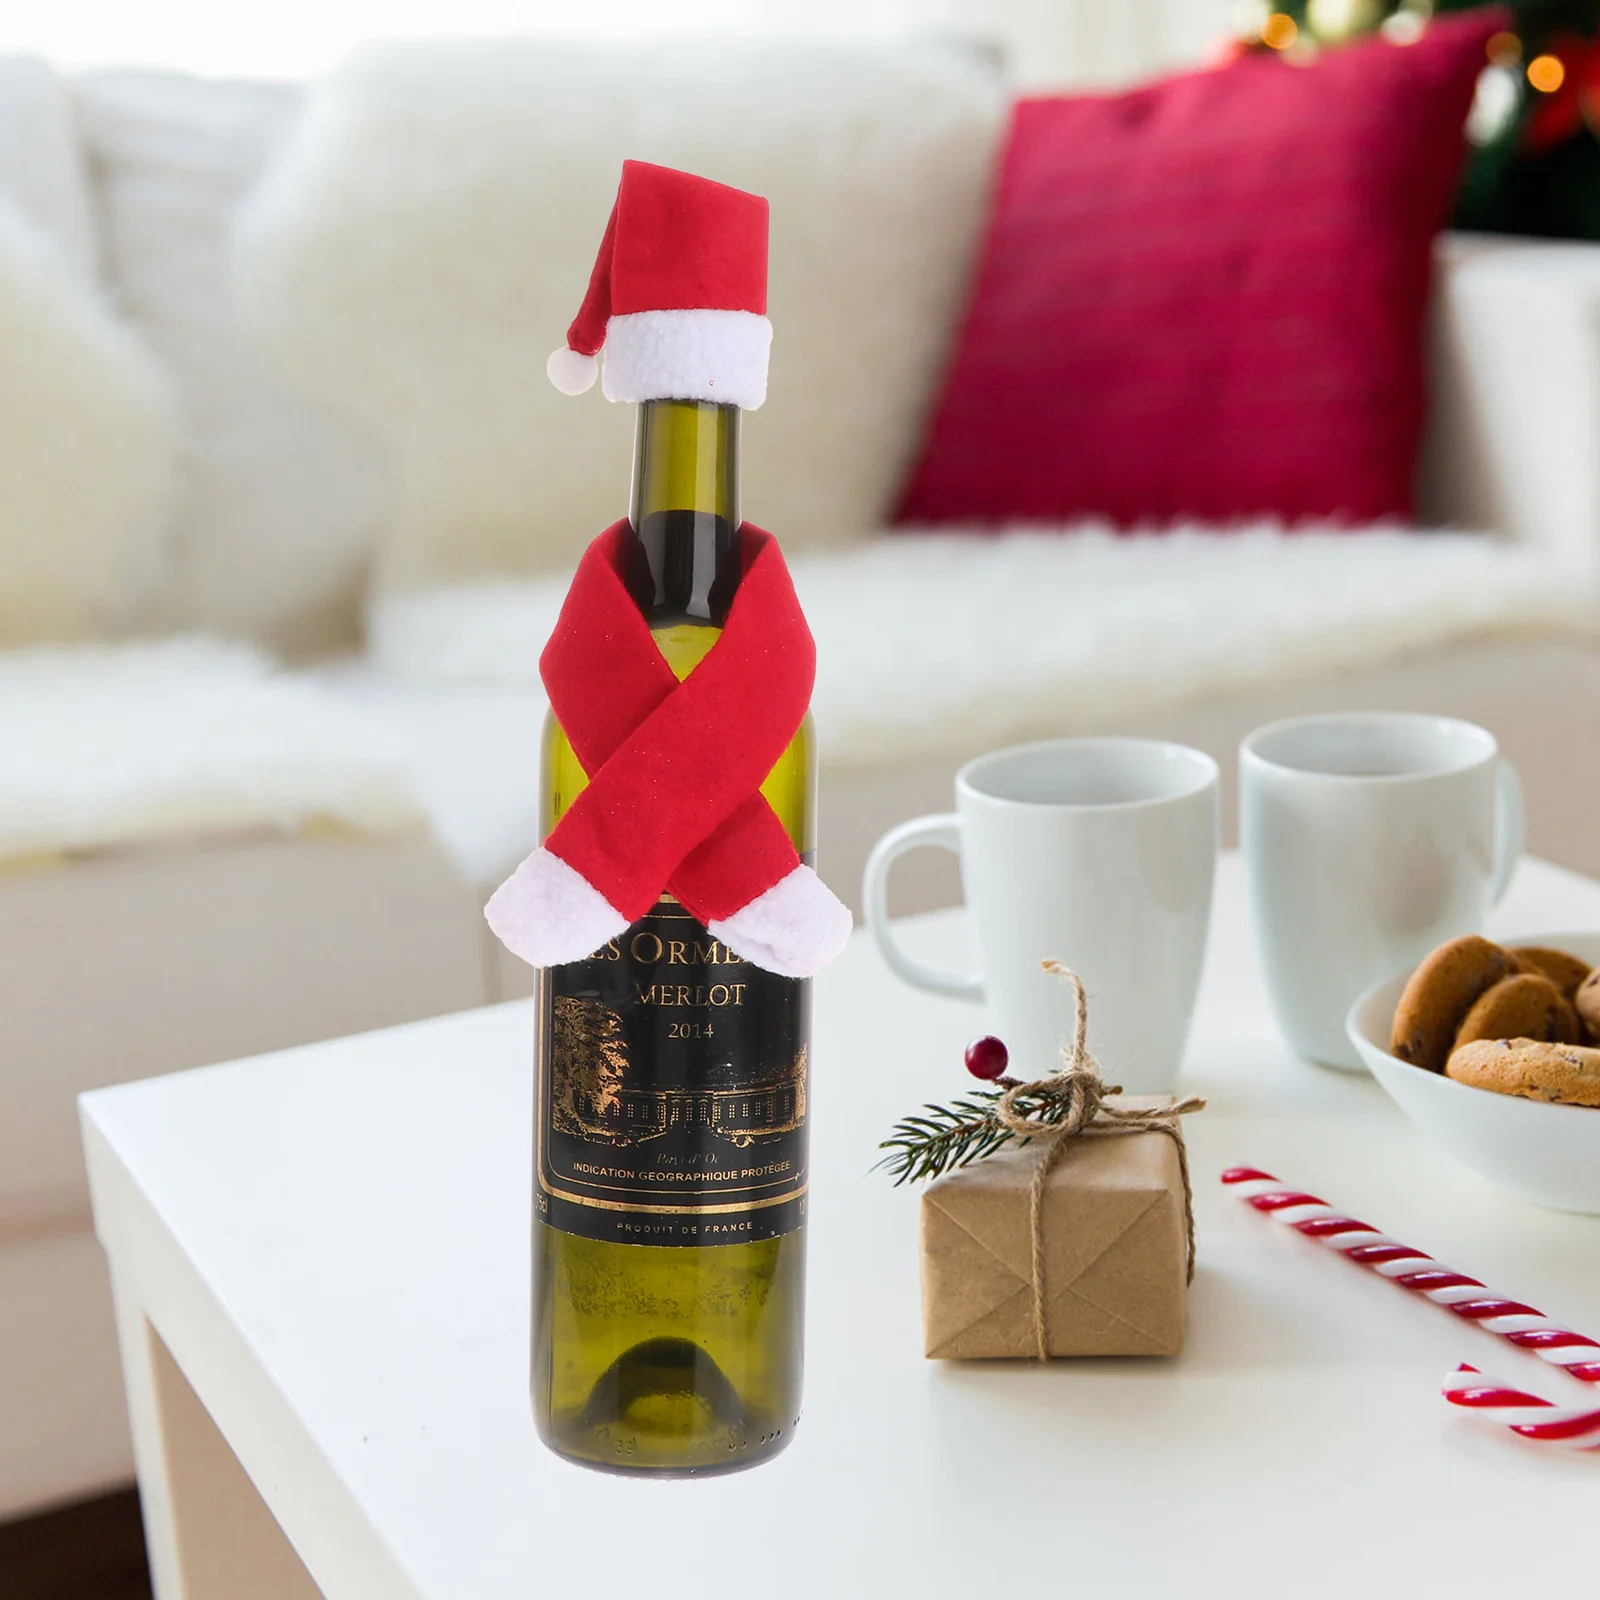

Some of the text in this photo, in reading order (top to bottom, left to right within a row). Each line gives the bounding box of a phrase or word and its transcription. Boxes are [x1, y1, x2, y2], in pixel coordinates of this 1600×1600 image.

[630, 931, 749, 965] ORME
[633, 983, 749, 1007] MERLOT
[667, 1022, 715, 1039] 2014
[573, 1161, 635, 1179] INDICATION
[638, 1169, 738, 1182] GEOGRAPHIQUE
[616, 1221, 754, 1235] PRODUIT DE FRANCE
